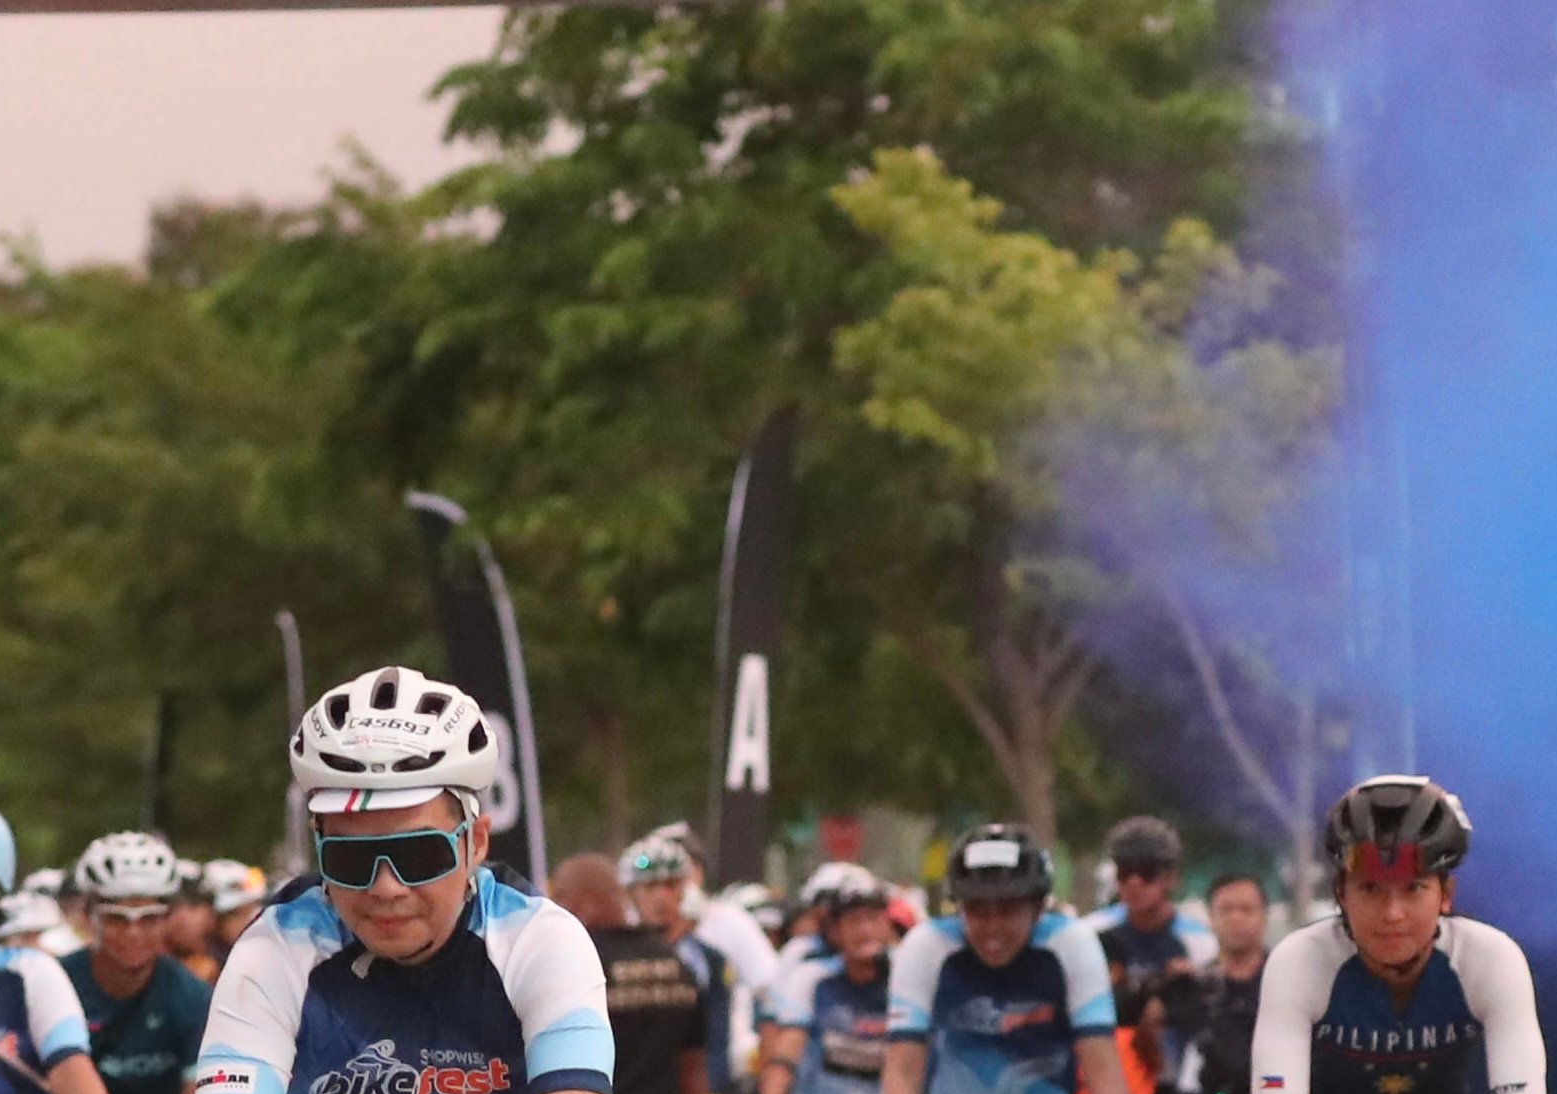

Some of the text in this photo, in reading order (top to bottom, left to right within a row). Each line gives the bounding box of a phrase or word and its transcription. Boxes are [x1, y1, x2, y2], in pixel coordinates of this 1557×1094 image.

[310, 706, 329, 739] UDY
[443, 703, 467, 735] RUD
[726, 653, 771, 795] A
[1317, 1022, 1477, 1051] PILIPINAS
